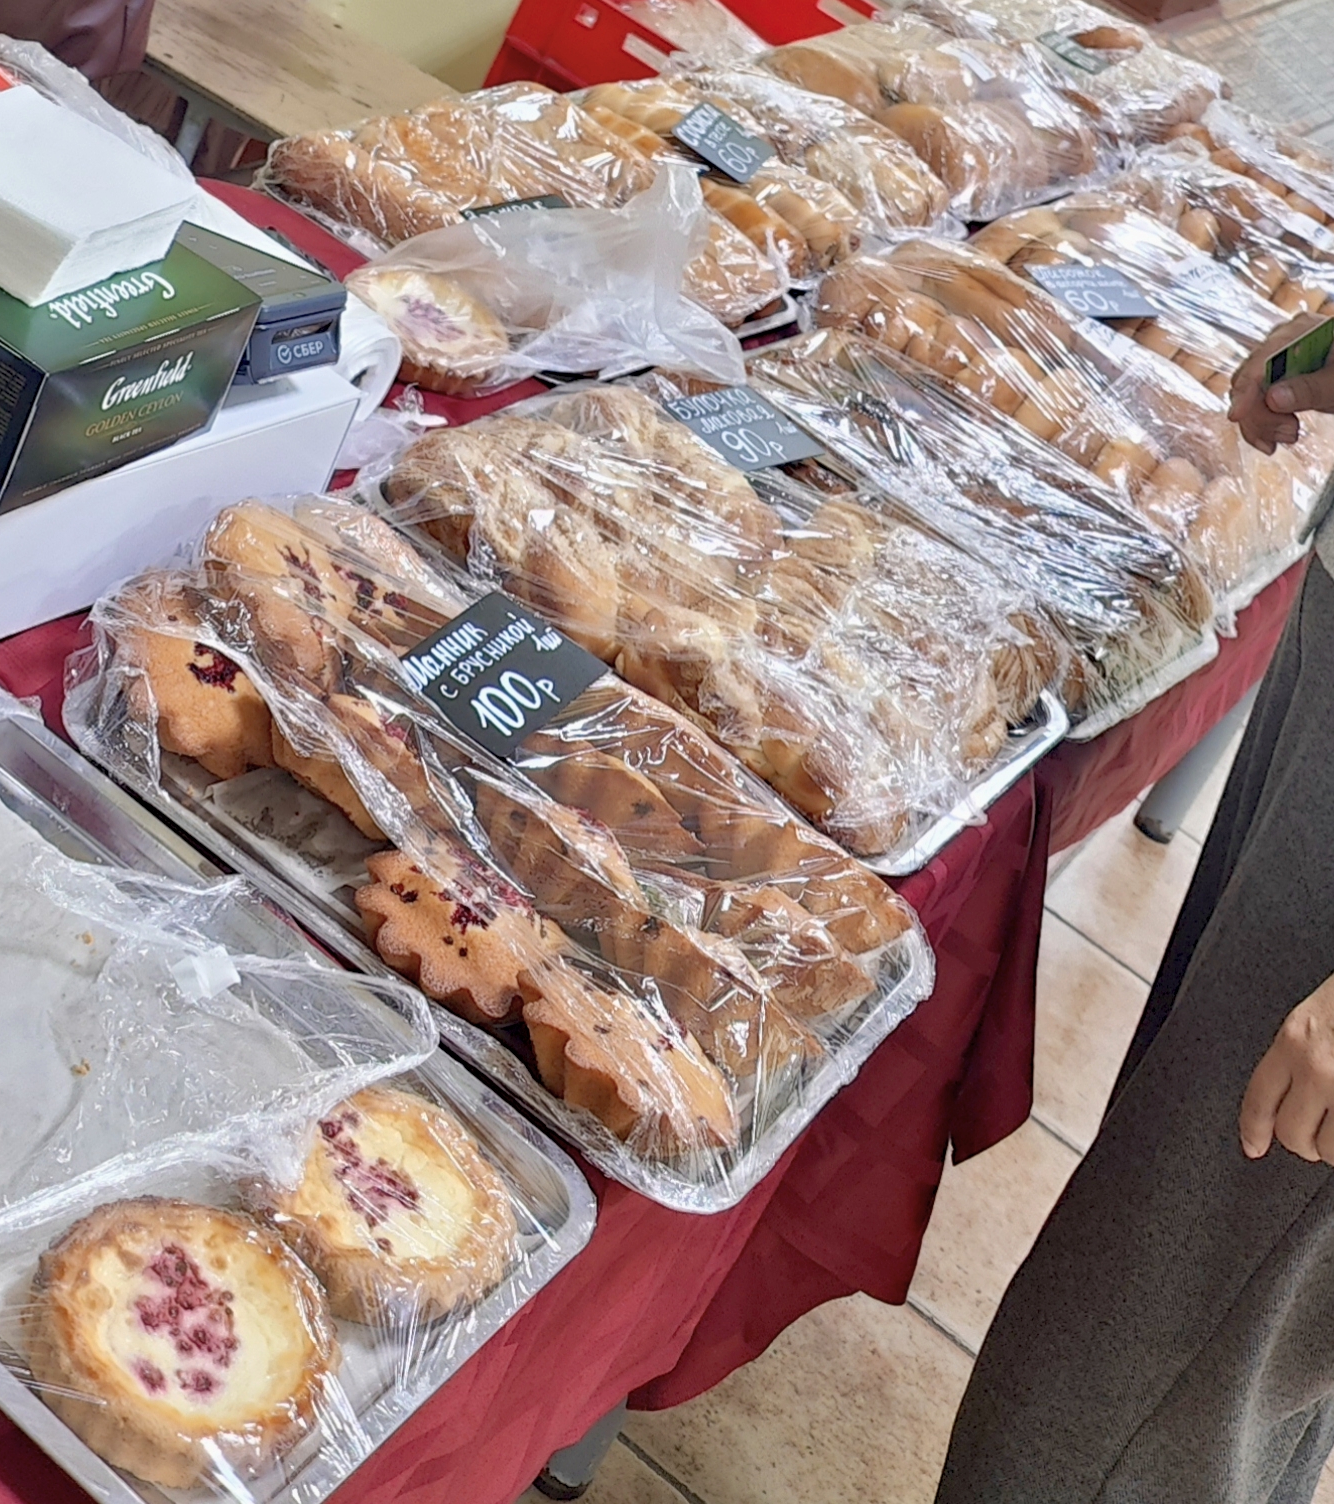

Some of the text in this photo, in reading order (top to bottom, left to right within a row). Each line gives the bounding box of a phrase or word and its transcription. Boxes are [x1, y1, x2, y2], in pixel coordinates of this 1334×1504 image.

[293, 340, 324, 359] СБЕР
[101, 351, 195, 411] Greenfield
[85, 391, 185, 437] GOLDEN CEYLON
